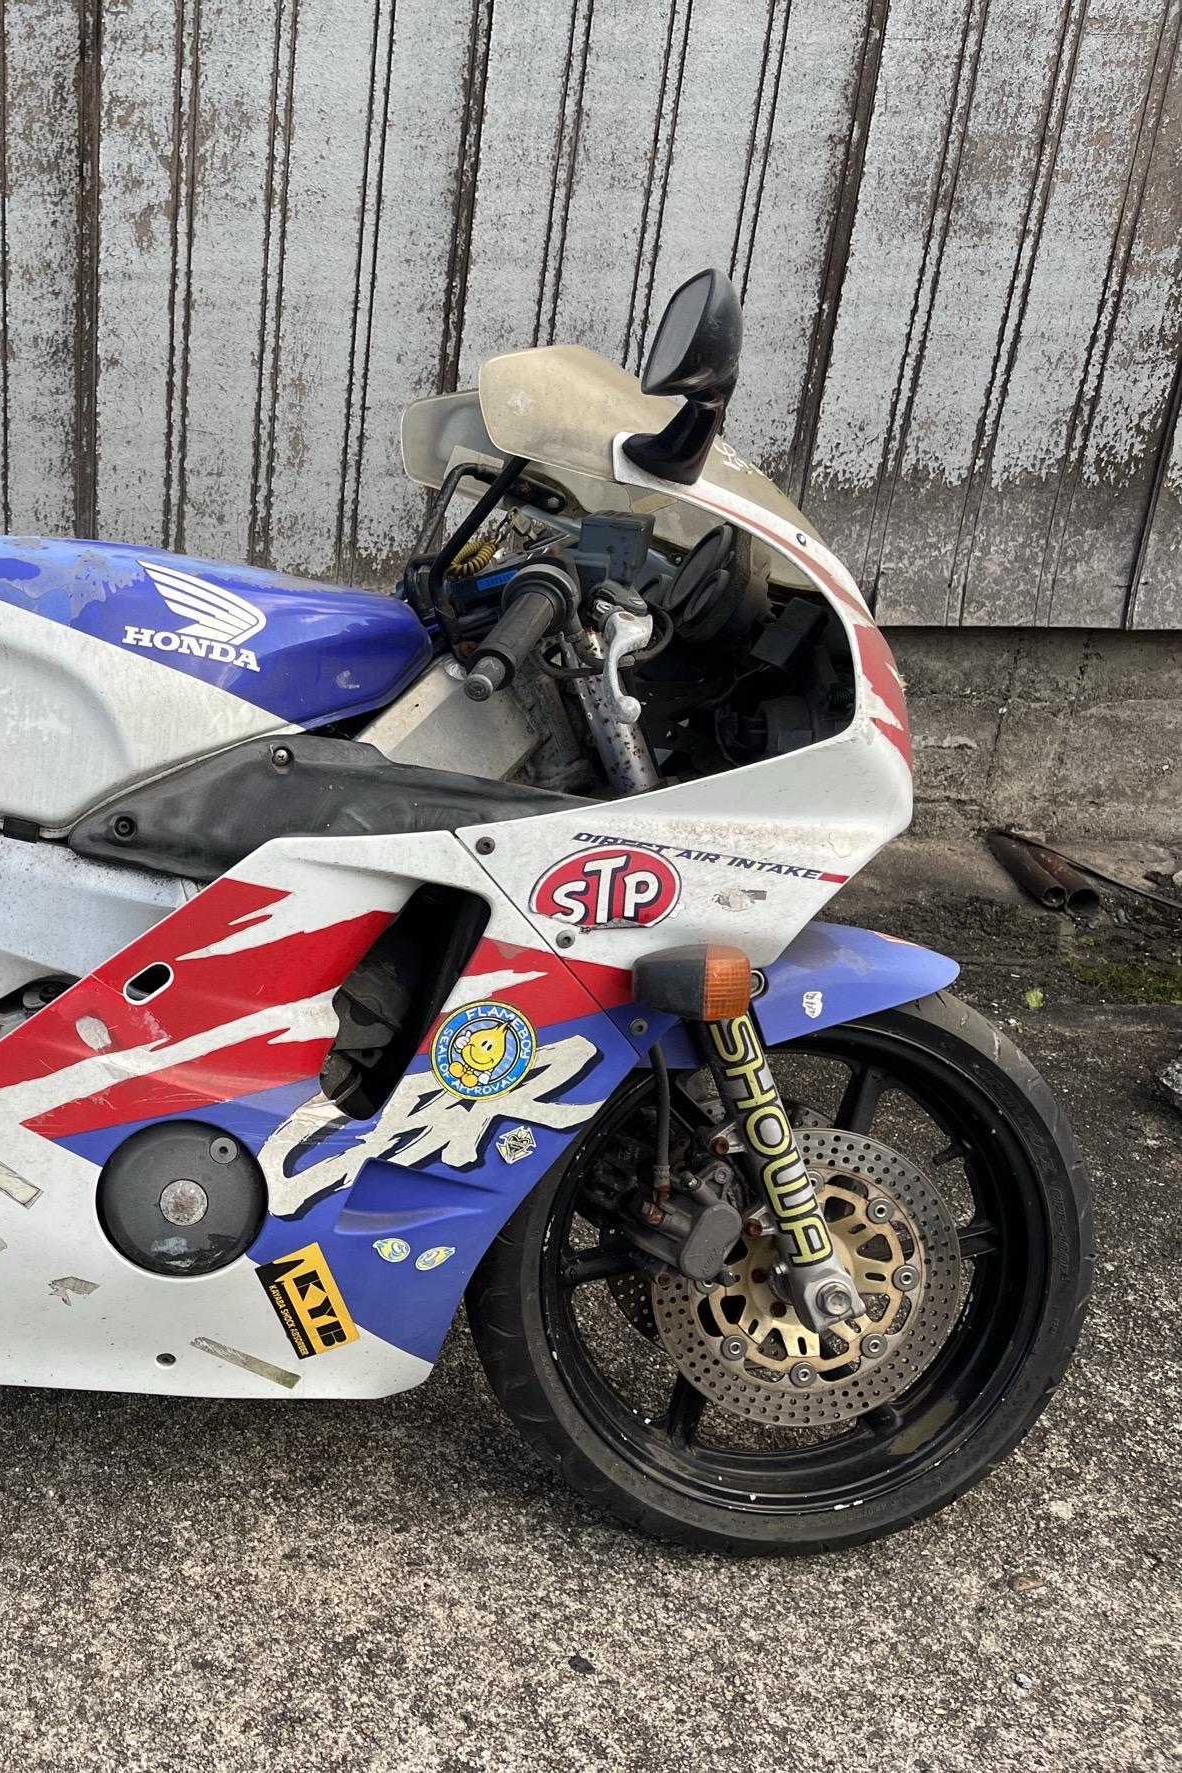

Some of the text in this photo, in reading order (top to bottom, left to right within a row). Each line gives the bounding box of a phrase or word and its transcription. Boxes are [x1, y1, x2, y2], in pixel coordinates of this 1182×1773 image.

[122, 625, 260, 672] HONDA
[551, 854, 660, 925] STP
[675, 849, 720, 864] AIR
[727, 856, 822, 880] INTAKE
[437, 1028, 454, 1062] SEAL
[450, 1075, 517, 1095] APPROVAL
[710, 1014, 833, 1265] SHOWA
[268, 1284, 310, 1357] KAYABA SHOCK ABSORBER
[293, 1269, 347, 1347] KYB
